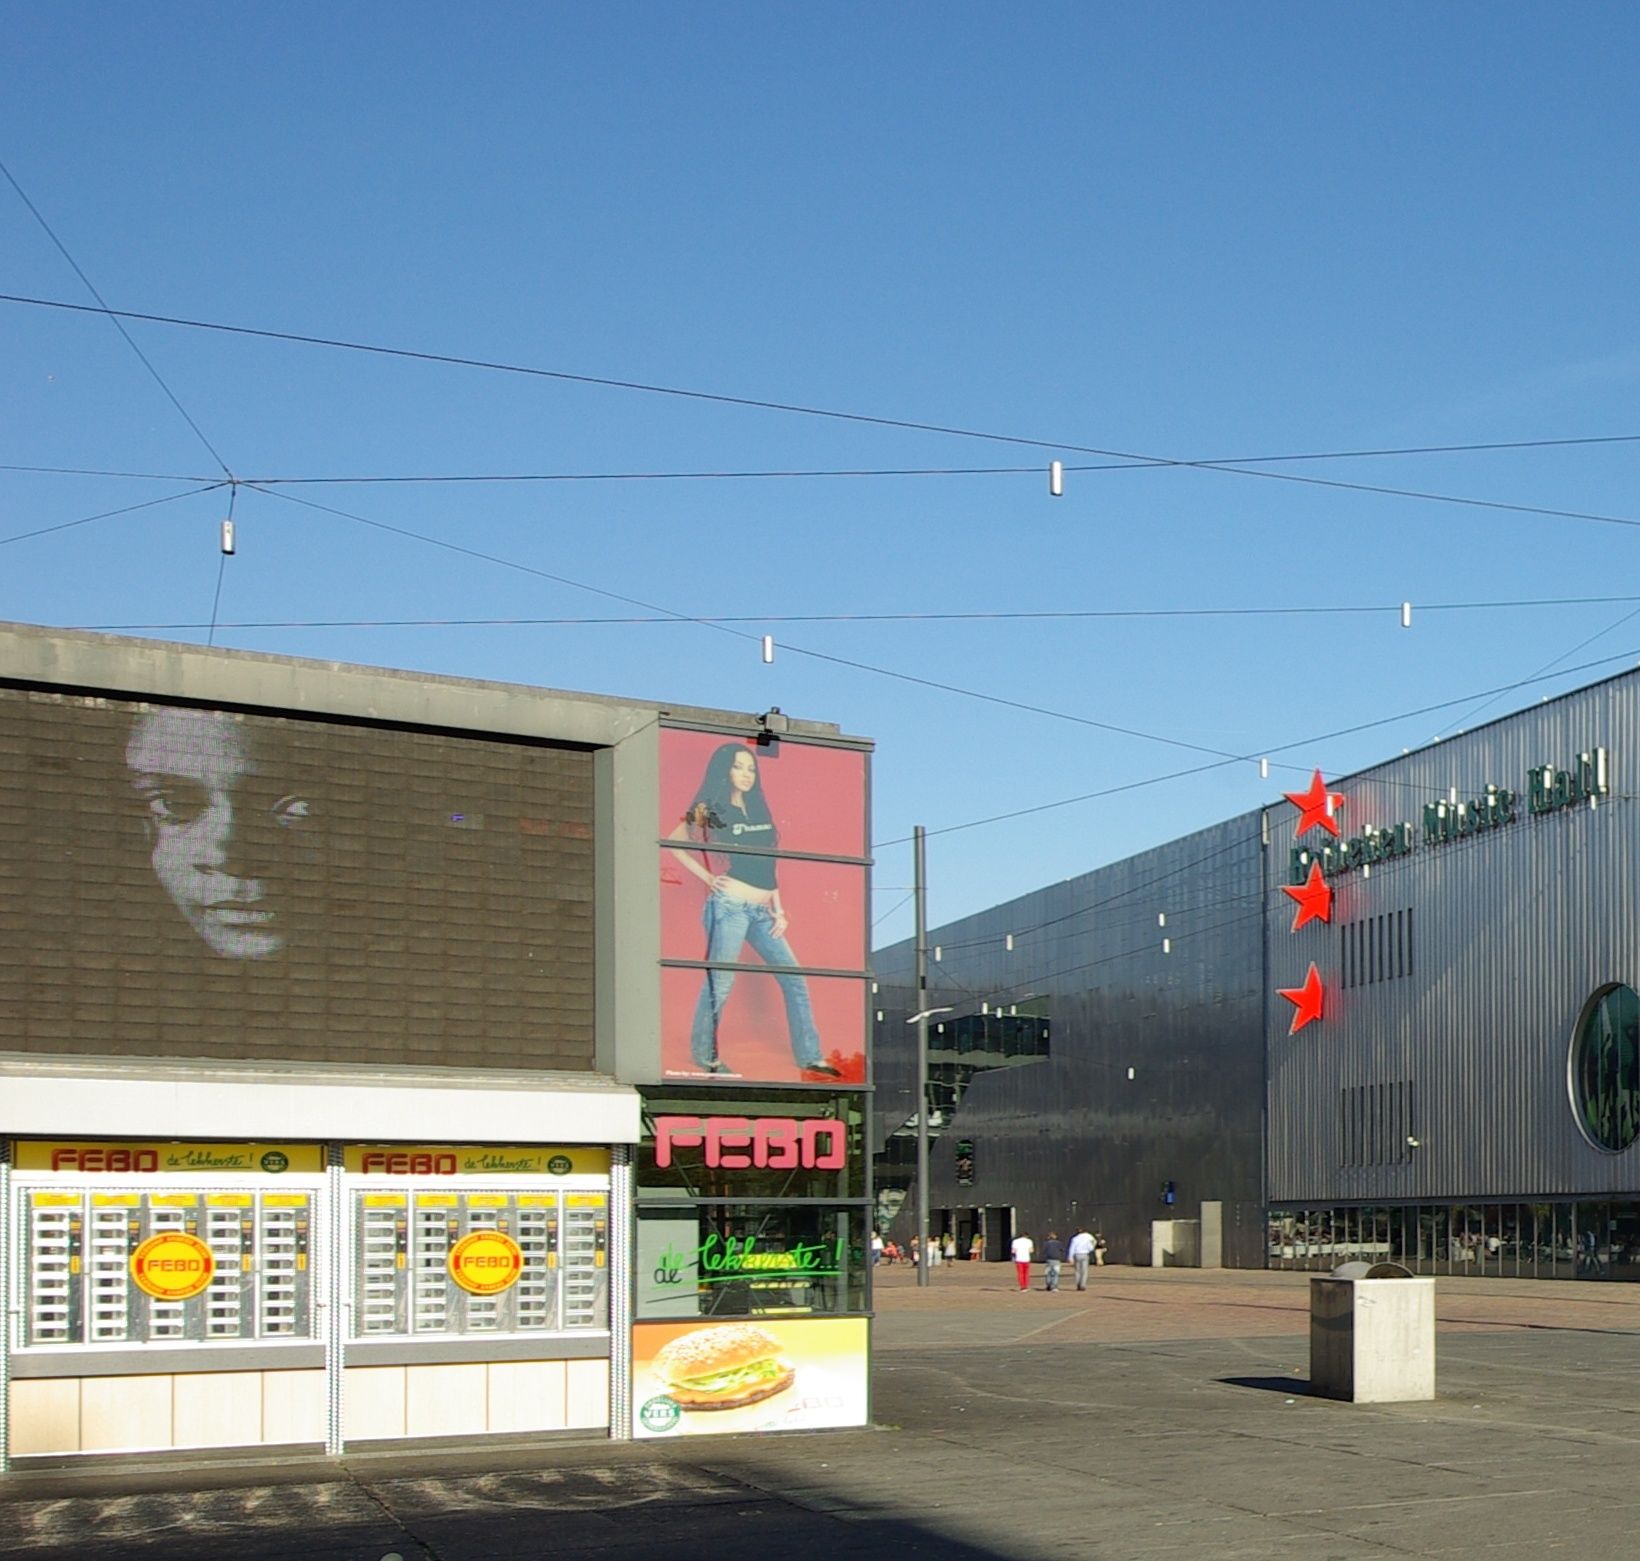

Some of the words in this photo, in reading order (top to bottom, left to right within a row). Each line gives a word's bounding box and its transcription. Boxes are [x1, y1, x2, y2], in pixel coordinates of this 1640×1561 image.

[1423, 784, 1516, 846] Music
[1527, 747, 1610, 815] Hall
[655, 1116, 847, 1169] FEBO
[51, 1149, 159, 1173] FEBO
[362, 1152, 457, 1175] FEBO
[147, 1259, 200, 1272] FEBO
[463, 1256, 510, 1268] FEBO
